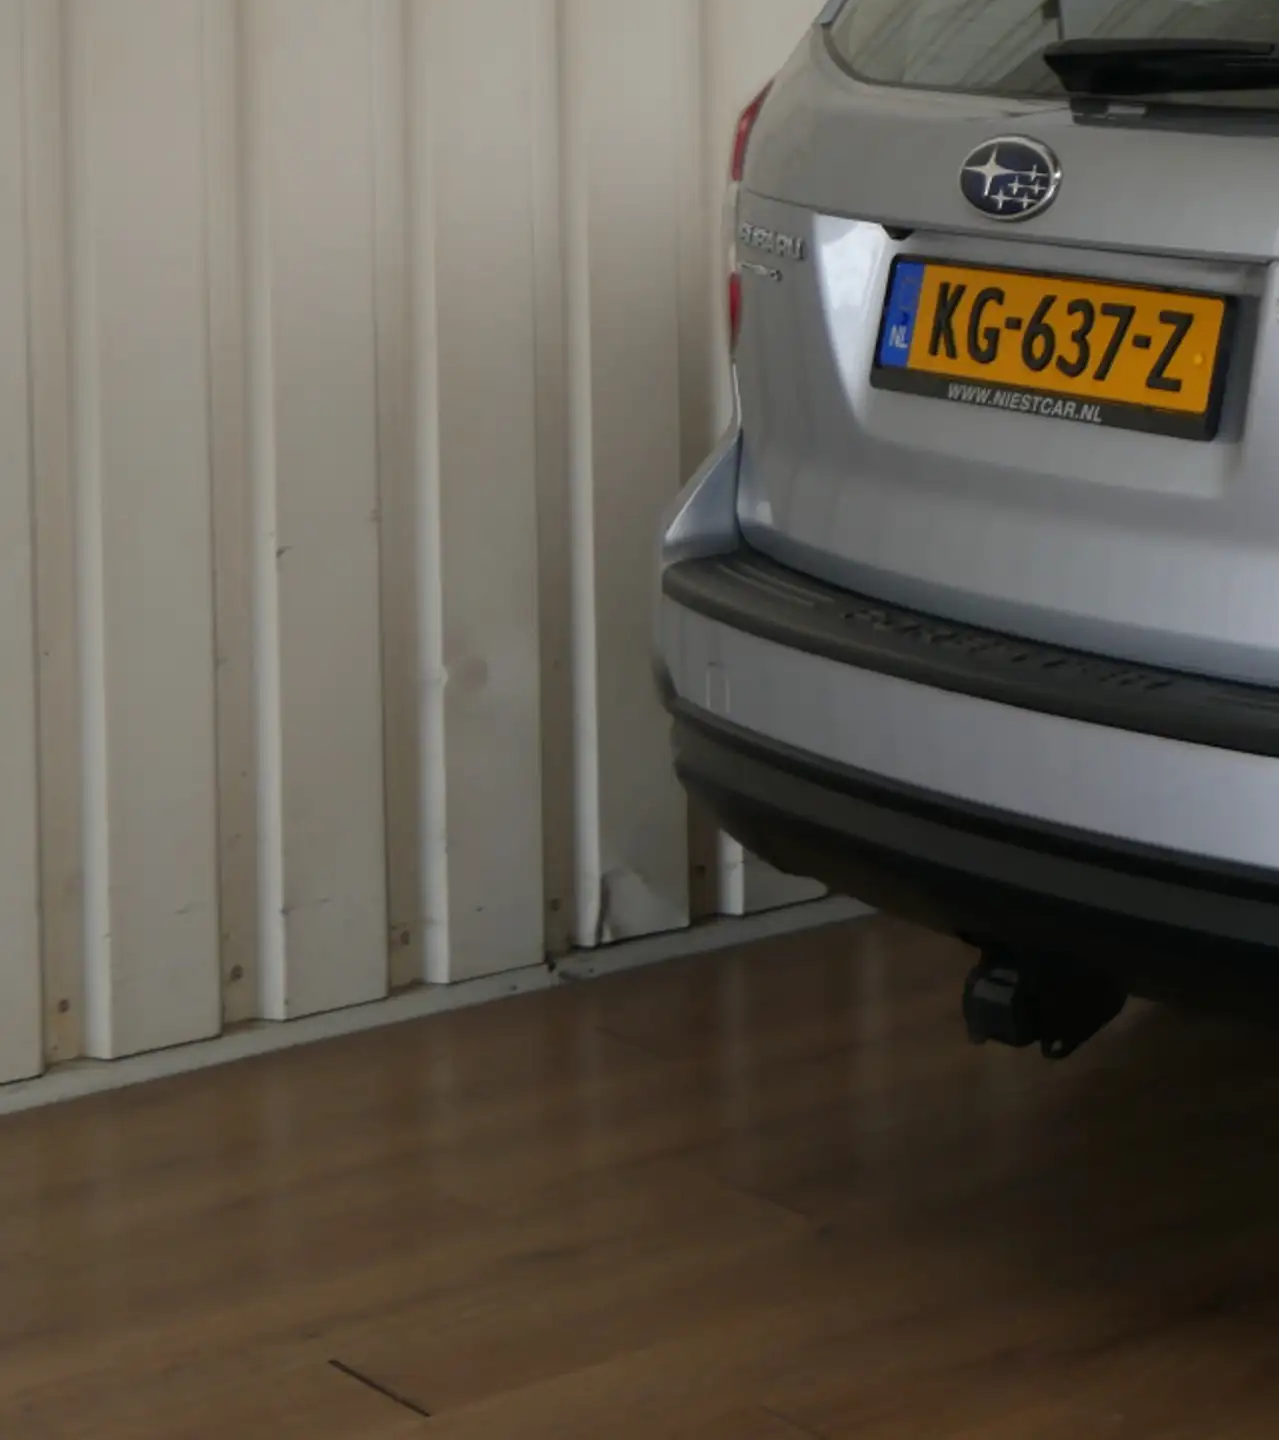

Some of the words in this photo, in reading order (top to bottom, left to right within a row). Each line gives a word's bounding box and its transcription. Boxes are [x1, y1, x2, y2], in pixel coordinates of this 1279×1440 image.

[889, 324, 908, 349] NL
[928, 281, 1194, 392] KG-637-Z
[948, 382, 1103, 423] WWW.NIESTCAR.NL
